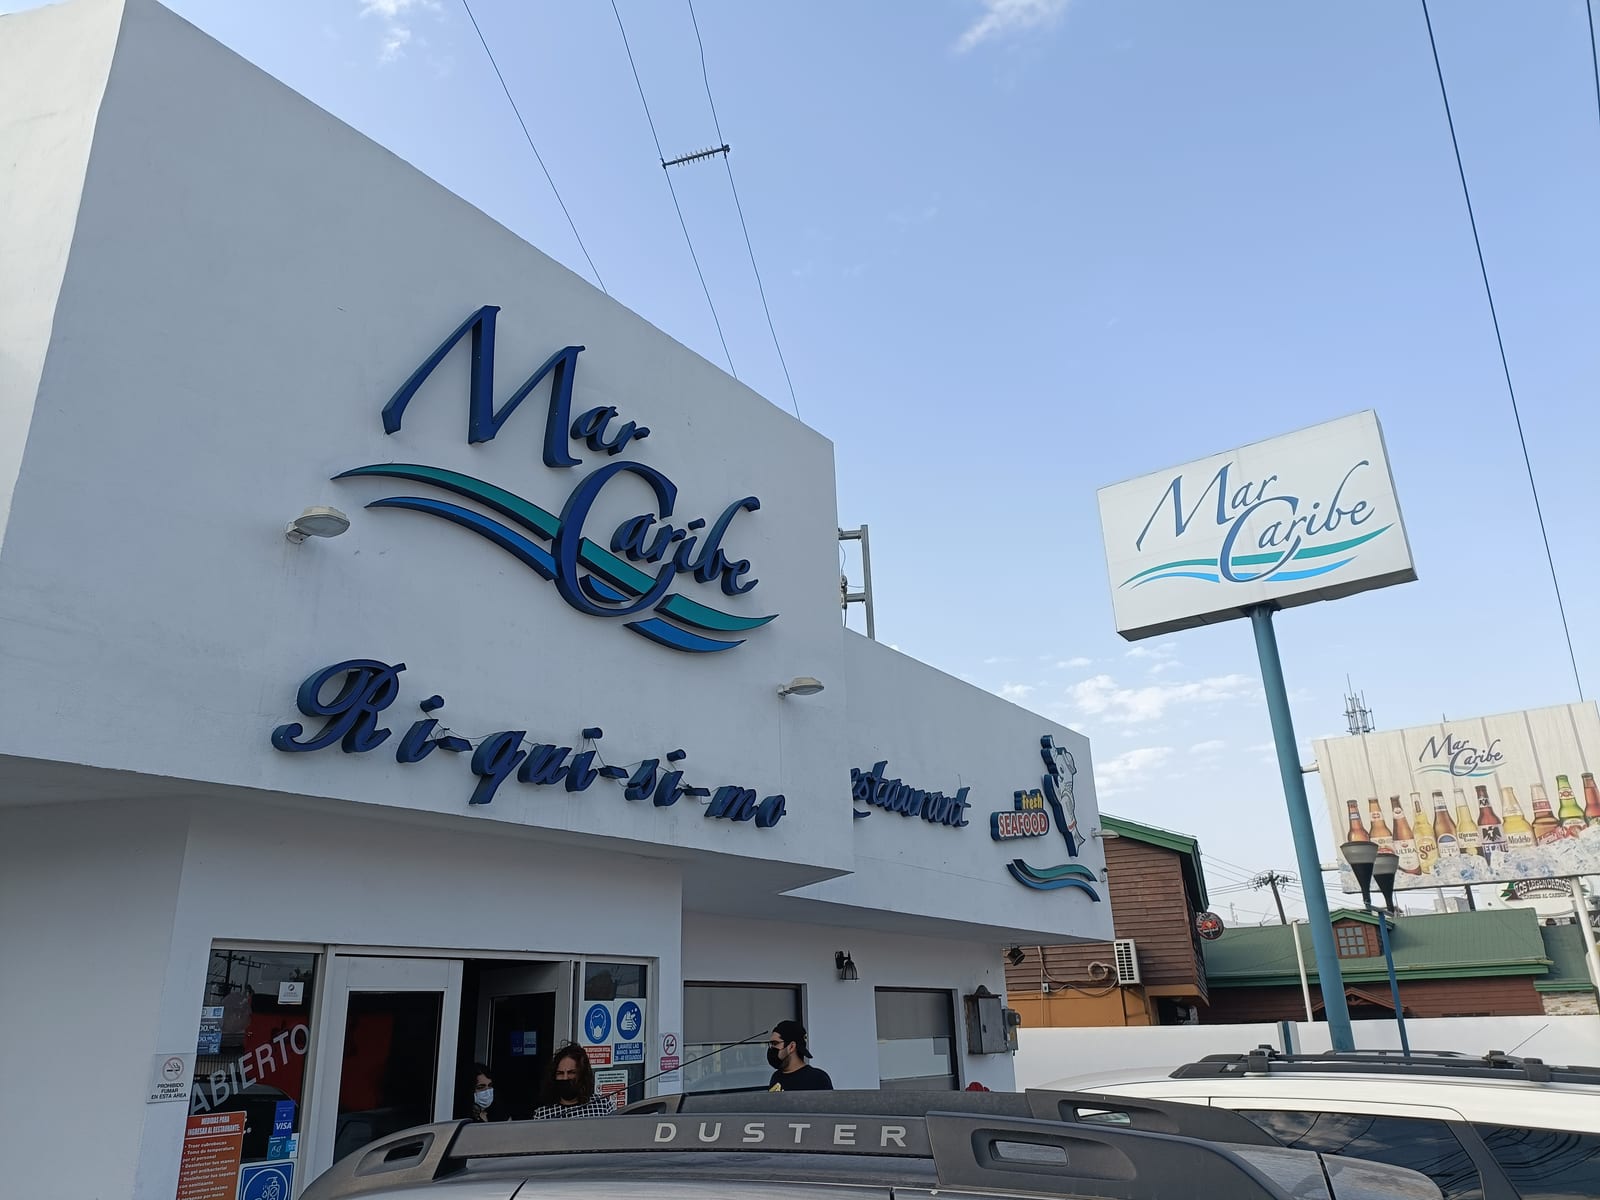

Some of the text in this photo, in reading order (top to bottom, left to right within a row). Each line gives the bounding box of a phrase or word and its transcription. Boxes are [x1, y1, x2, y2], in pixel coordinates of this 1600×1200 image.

[380, 304, 650, 468] Mar
[1136, 461, 1277, 552] Mar
[1219, 460, 1376, 583] Caribe
[550, 460, 761, 617] Caribe
[1418, 733, 1470, 763] Mar
[1449, 739, 1503, 777] Caribe
[851, 760, 972, 828] estaurant
[1021, 792, 1043, 810] fresh
[998, 812, 1049, 837] SEAFOOD
[1507, 835, 1531, 844] Modelo
[1395, 847, 1417, 855] ULTRA
[1514, 878, 1572, 895] LOS LEGENDARIOS
[189, 1023, 310, 1115] ABIERTO
[275, 1121, 292, 1130] VISA
[653, 1122, 907, 1147] DUSTER
